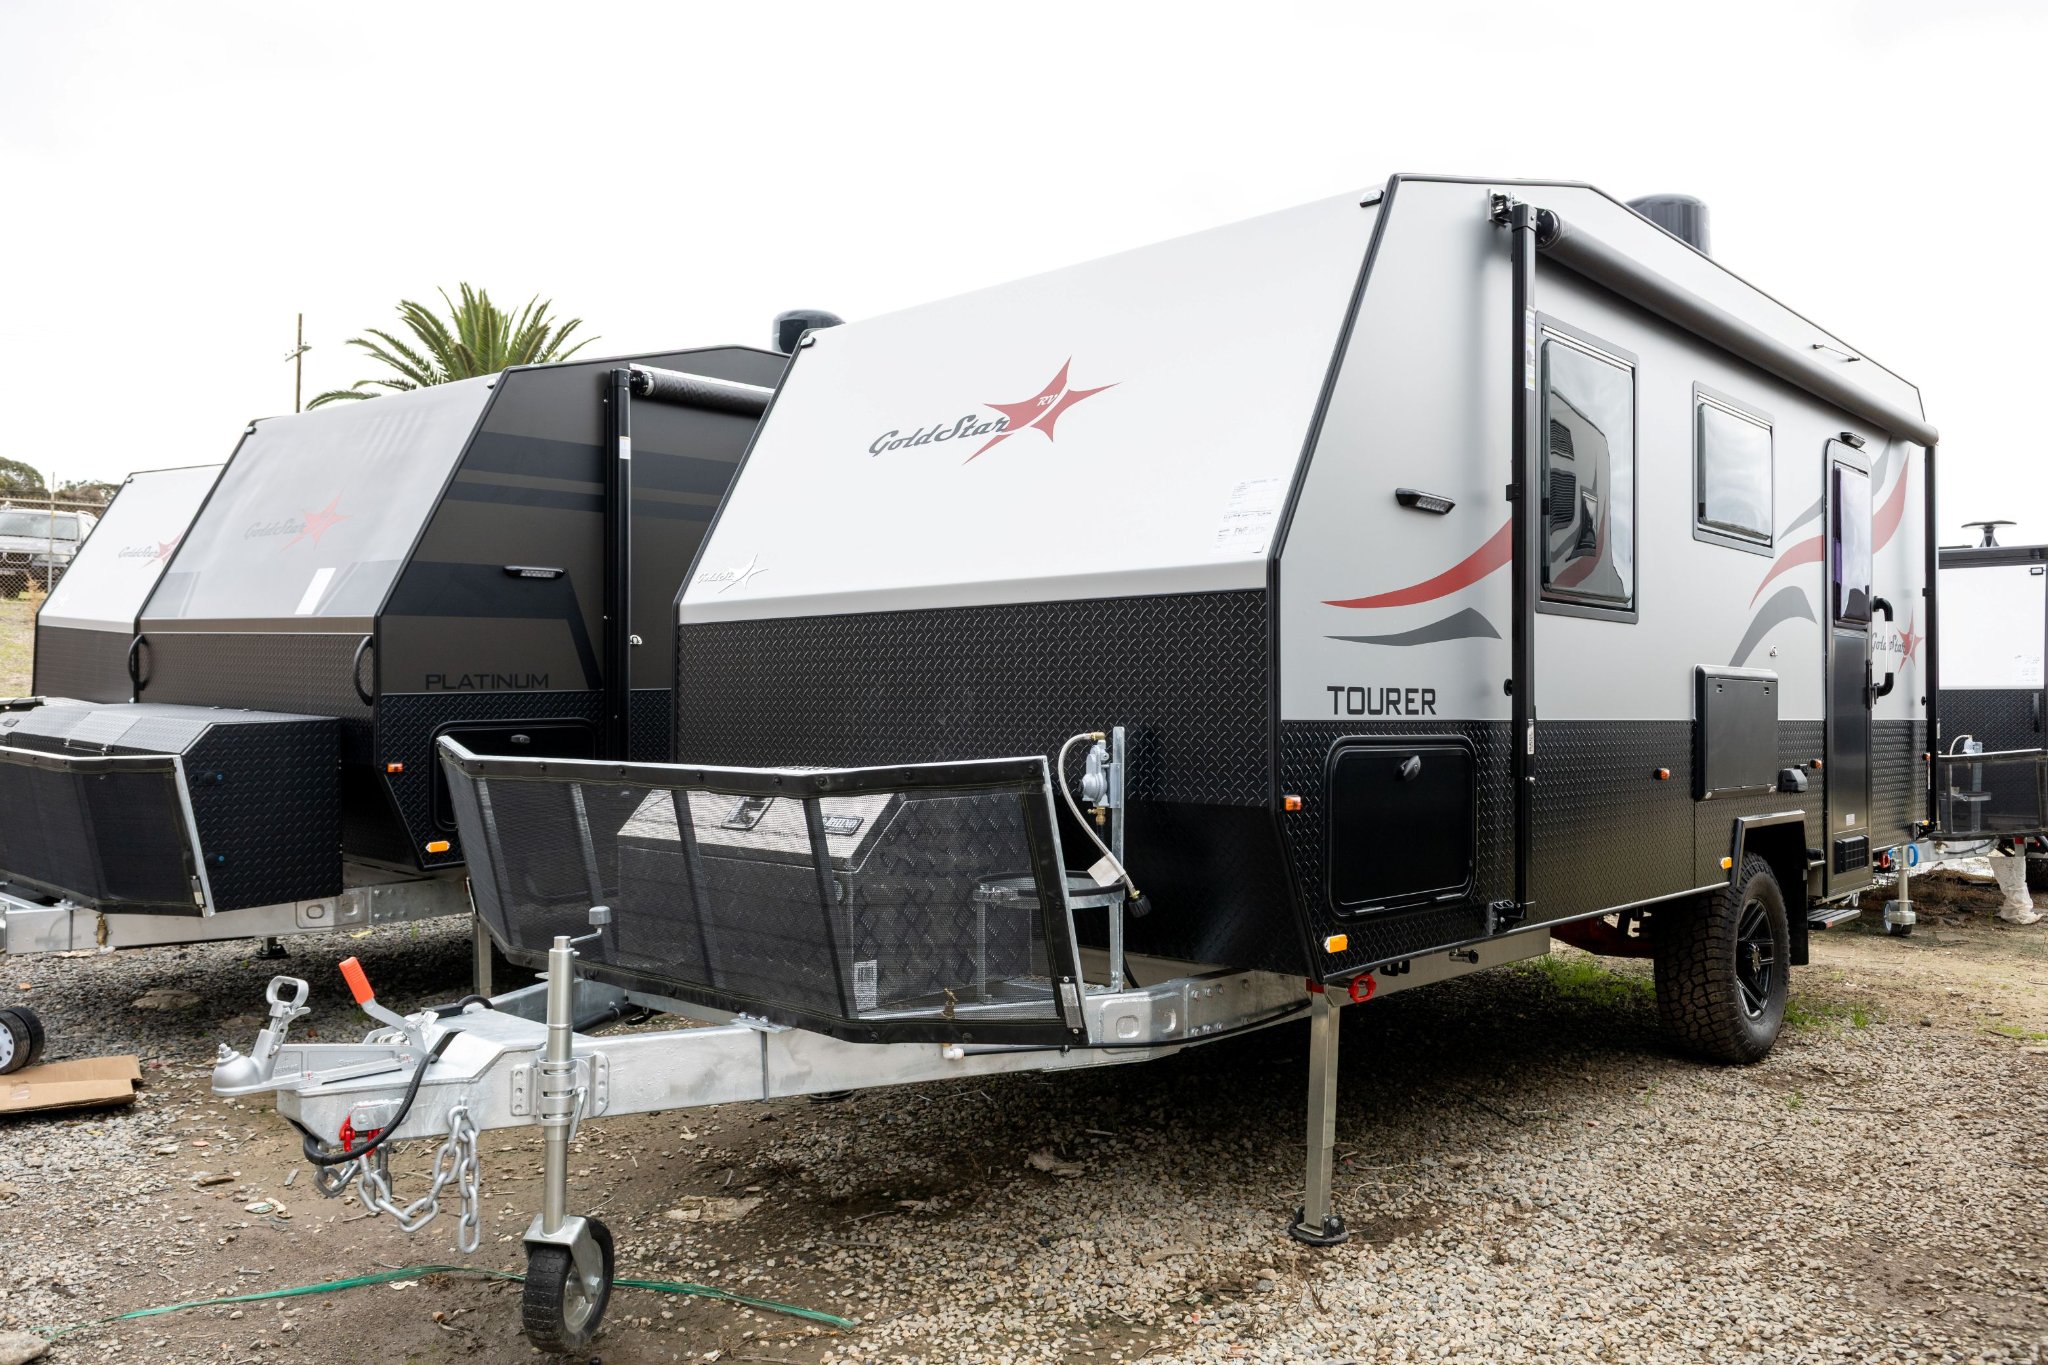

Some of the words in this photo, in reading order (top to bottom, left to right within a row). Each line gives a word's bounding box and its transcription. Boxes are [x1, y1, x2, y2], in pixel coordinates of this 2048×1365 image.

[1037, 393, 1060, 406] RV
[868, 414, 1010, 458] GoldStar
[425, 673, 549, 690] PLATINUM
[1326, 685, 1437, 715] TOURER
